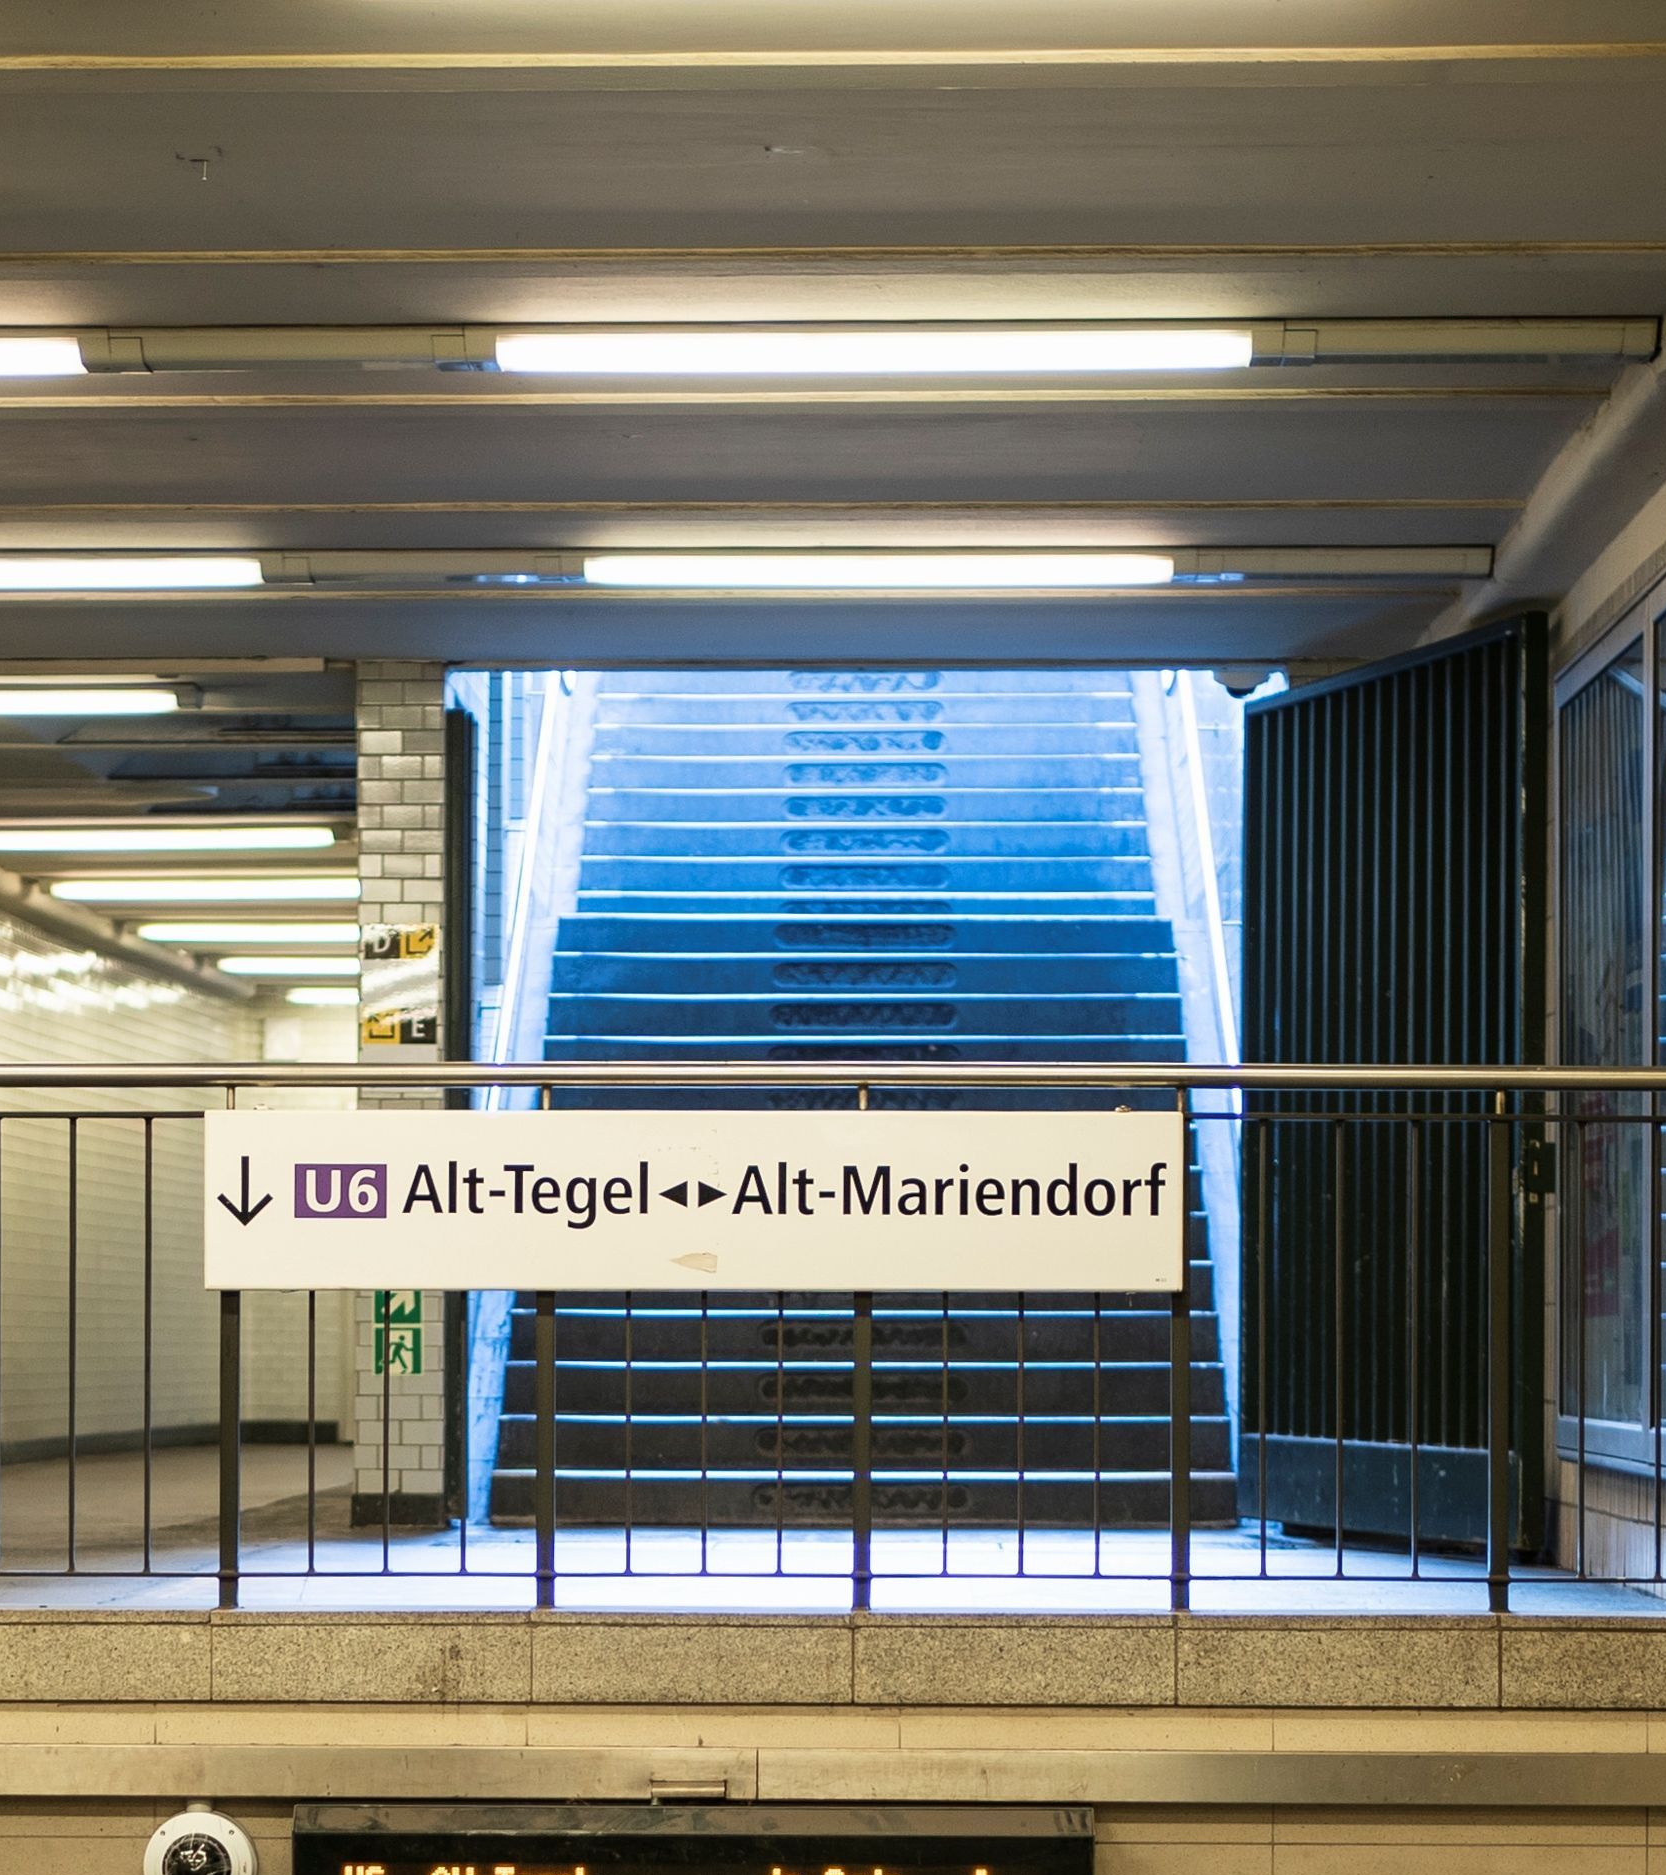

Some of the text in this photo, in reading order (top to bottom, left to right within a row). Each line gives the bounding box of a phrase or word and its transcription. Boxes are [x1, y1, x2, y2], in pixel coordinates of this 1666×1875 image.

[305, 1161, 1167, 1229] U6 Alt-Tegel Alt-Mariendorf
